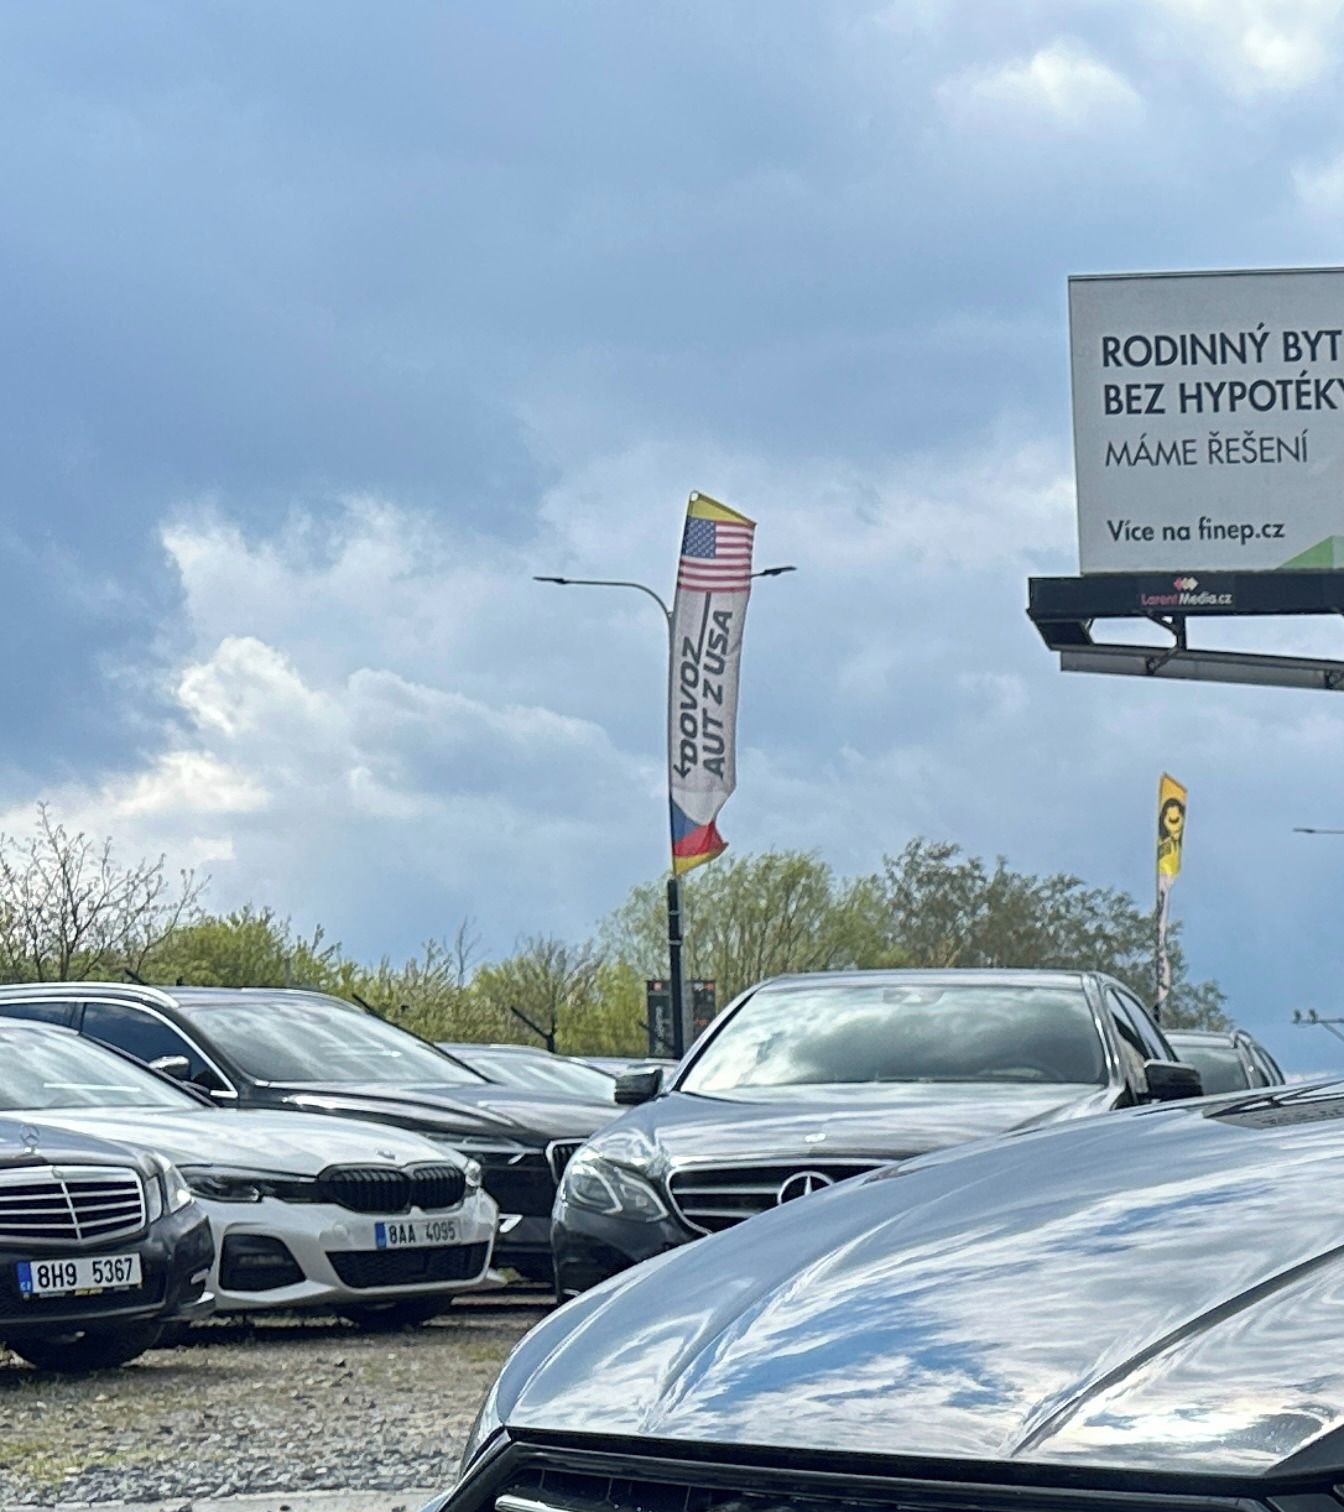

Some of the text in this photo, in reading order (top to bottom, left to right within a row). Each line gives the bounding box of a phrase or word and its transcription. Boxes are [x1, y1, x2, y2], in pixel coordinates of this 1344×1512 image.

[1102, 322, 1342, 367] RODINNÝ BYT
[1103, 383, 1166, 415] BEZ
[1105, 429, 1309, 467] MÁME ŘEŠENÍ
[1107, 515, 1286, 545] Více na finep.cz
[680, 637, 700, 766] DOVOZ
[703, 610, 733, 780] AUT Z USA
[388, 1224, 416, 1244] 8AA
[37, 1263, 78, 1288] 8H9
[92, 1258, 133, 1284] 5367
